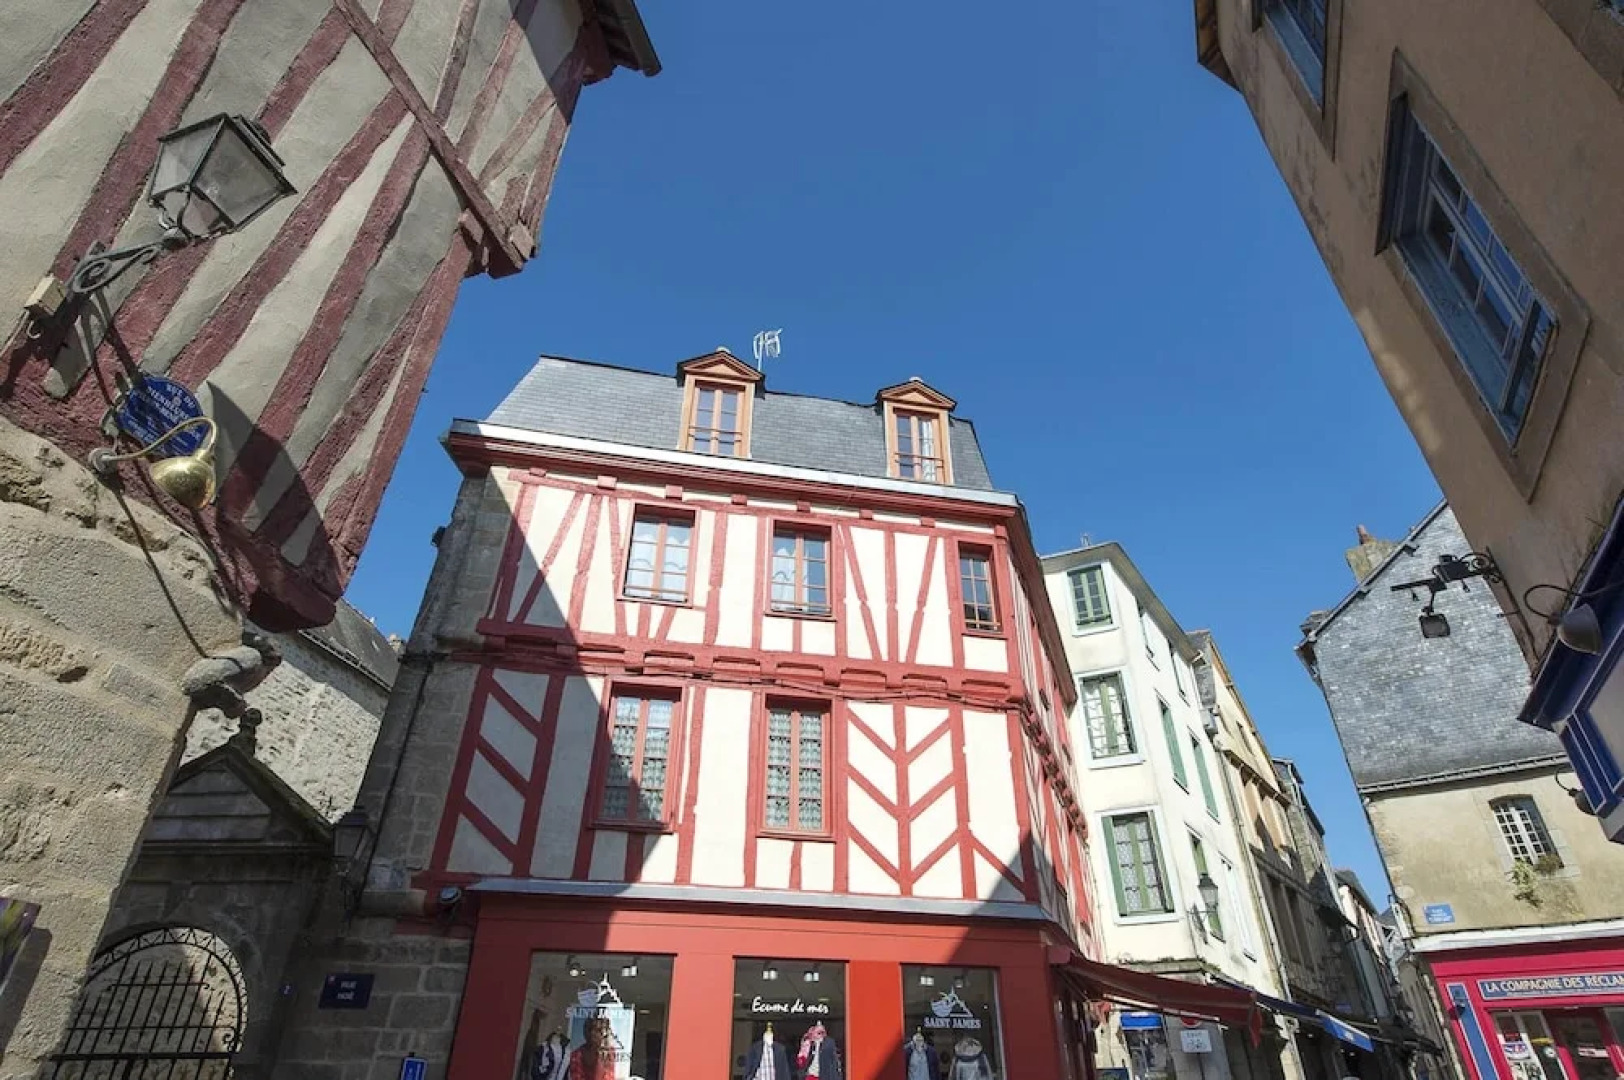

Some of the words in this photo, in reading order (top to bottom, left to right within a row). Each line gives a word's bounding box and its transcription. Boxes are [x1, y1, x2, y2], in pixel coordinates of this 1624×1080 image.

[1485, 982, 1500, 993] LA
[1501, 979, 1561, 991] COMPAGNIE
[1563, 977, 1585, 988] DES
[790, 998, 805, 1013] de
[564, 1008, 595, 1019] SAINT
[923, 1016, 951, 1029] SAINT
[952, 1018, 982, 1029] JAMES
